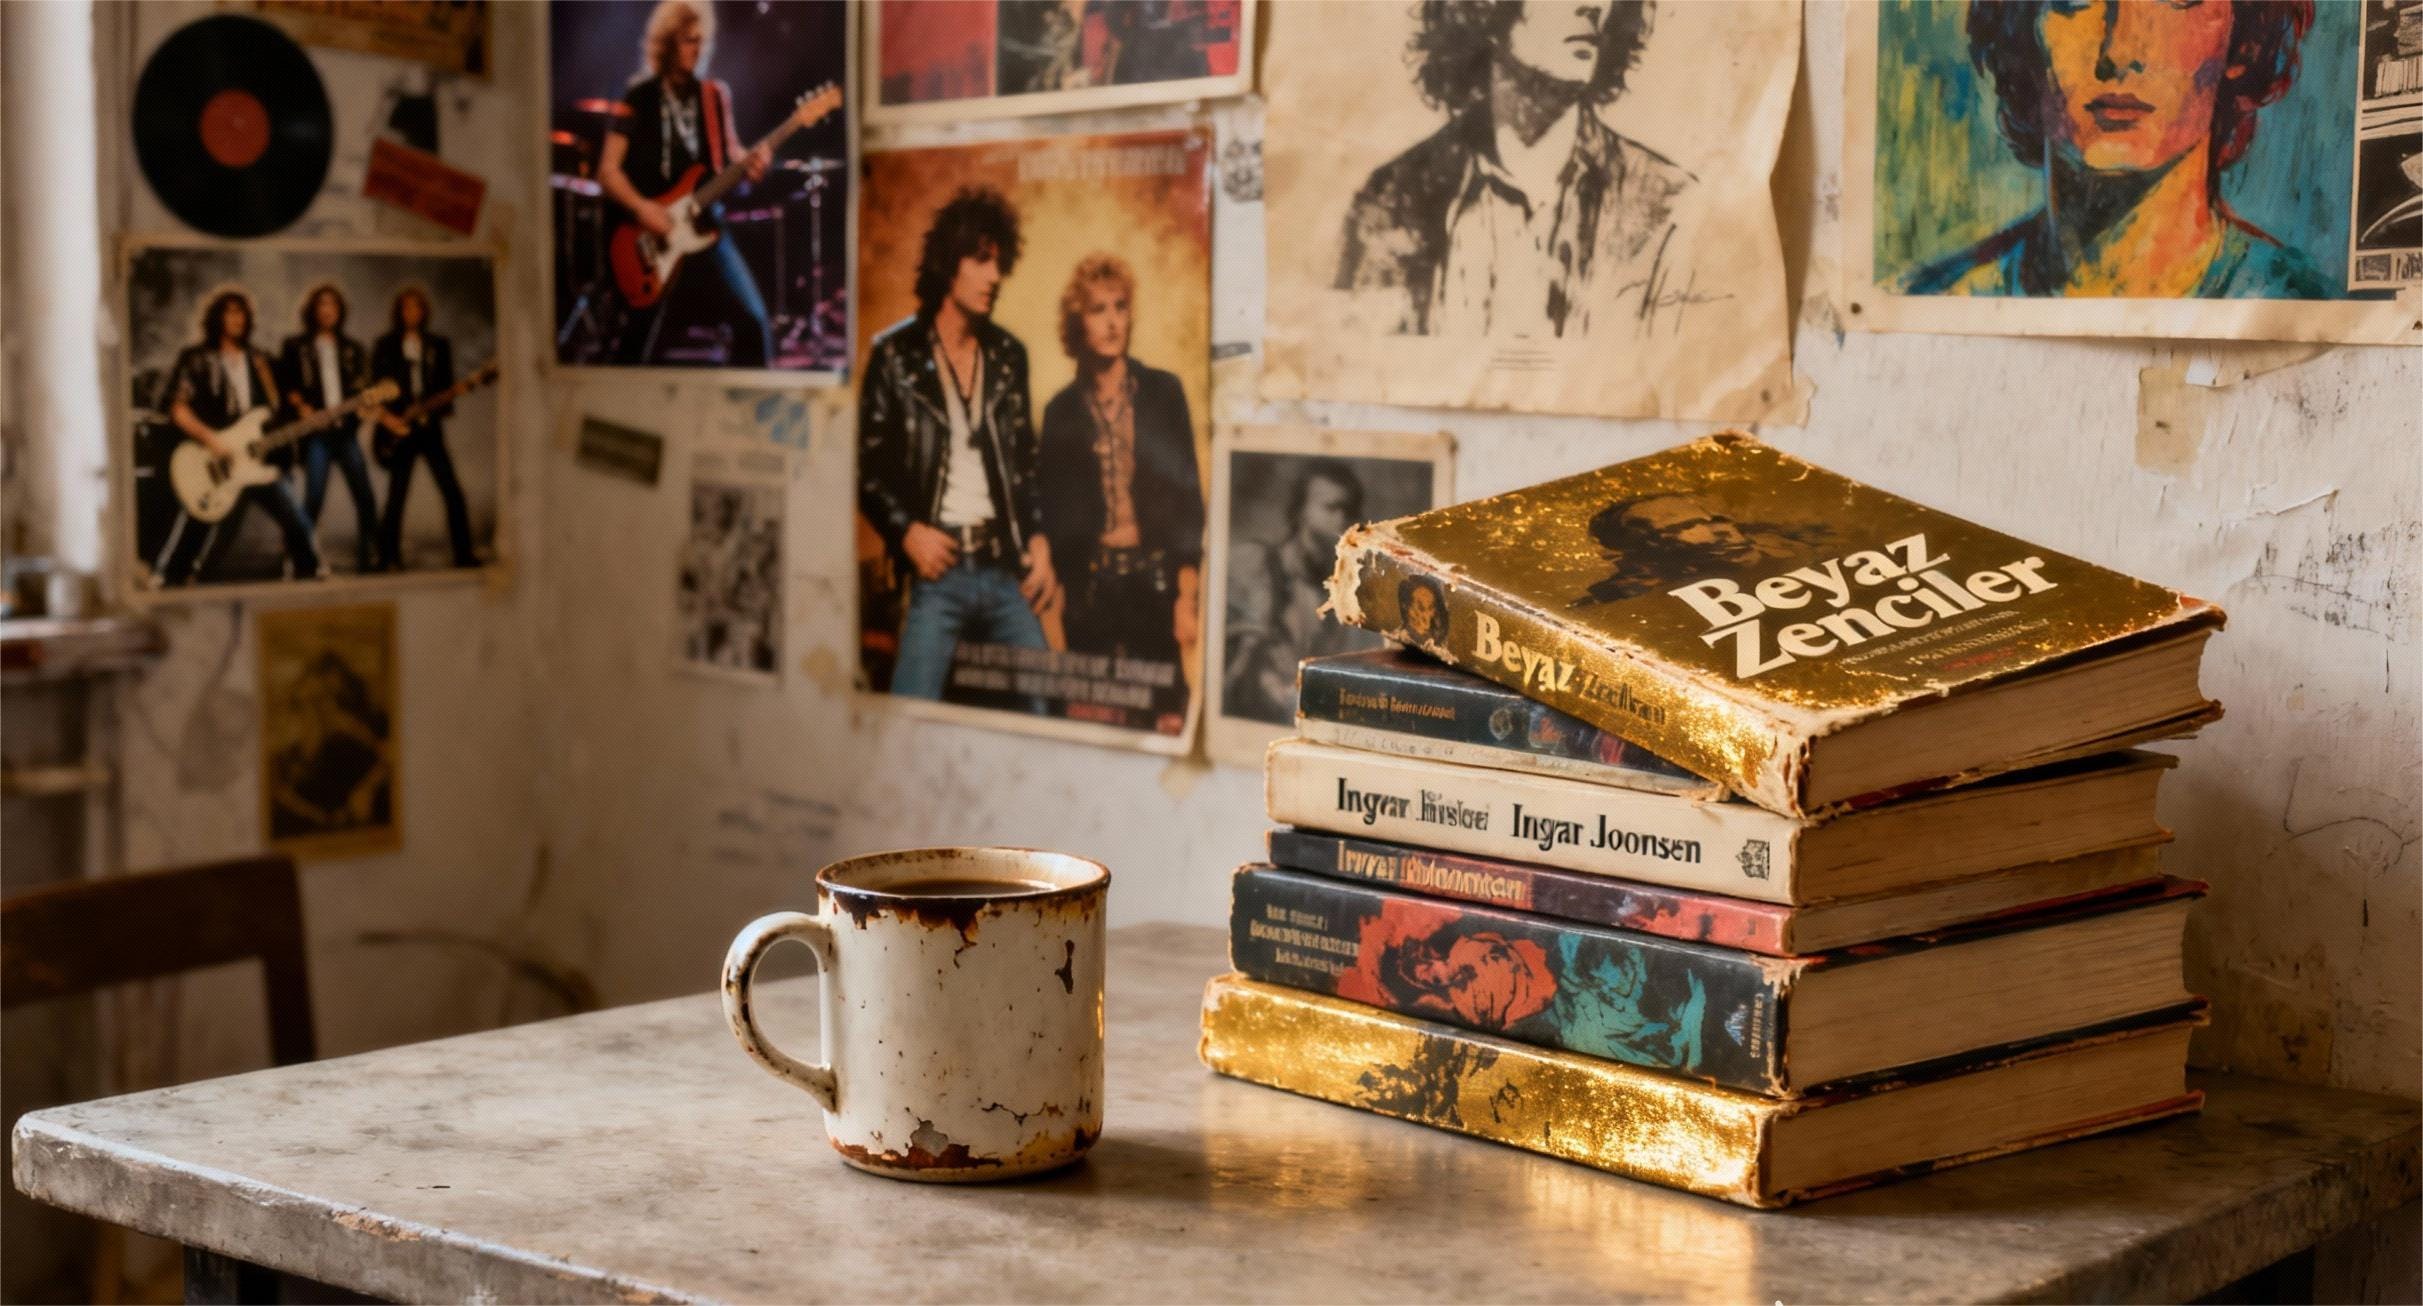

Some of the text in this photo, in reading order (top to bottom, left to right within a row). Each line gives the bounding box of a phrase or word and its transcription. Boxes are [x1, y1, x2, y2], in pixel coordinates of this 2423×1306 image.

[1668, 533, 1951, 631] Beyaz
[1700, 556, 2058, 679] Zenciler
[1472, 610, 1576, 692] Beyaz
[1590, 814, 1701, 863] Joonsen
